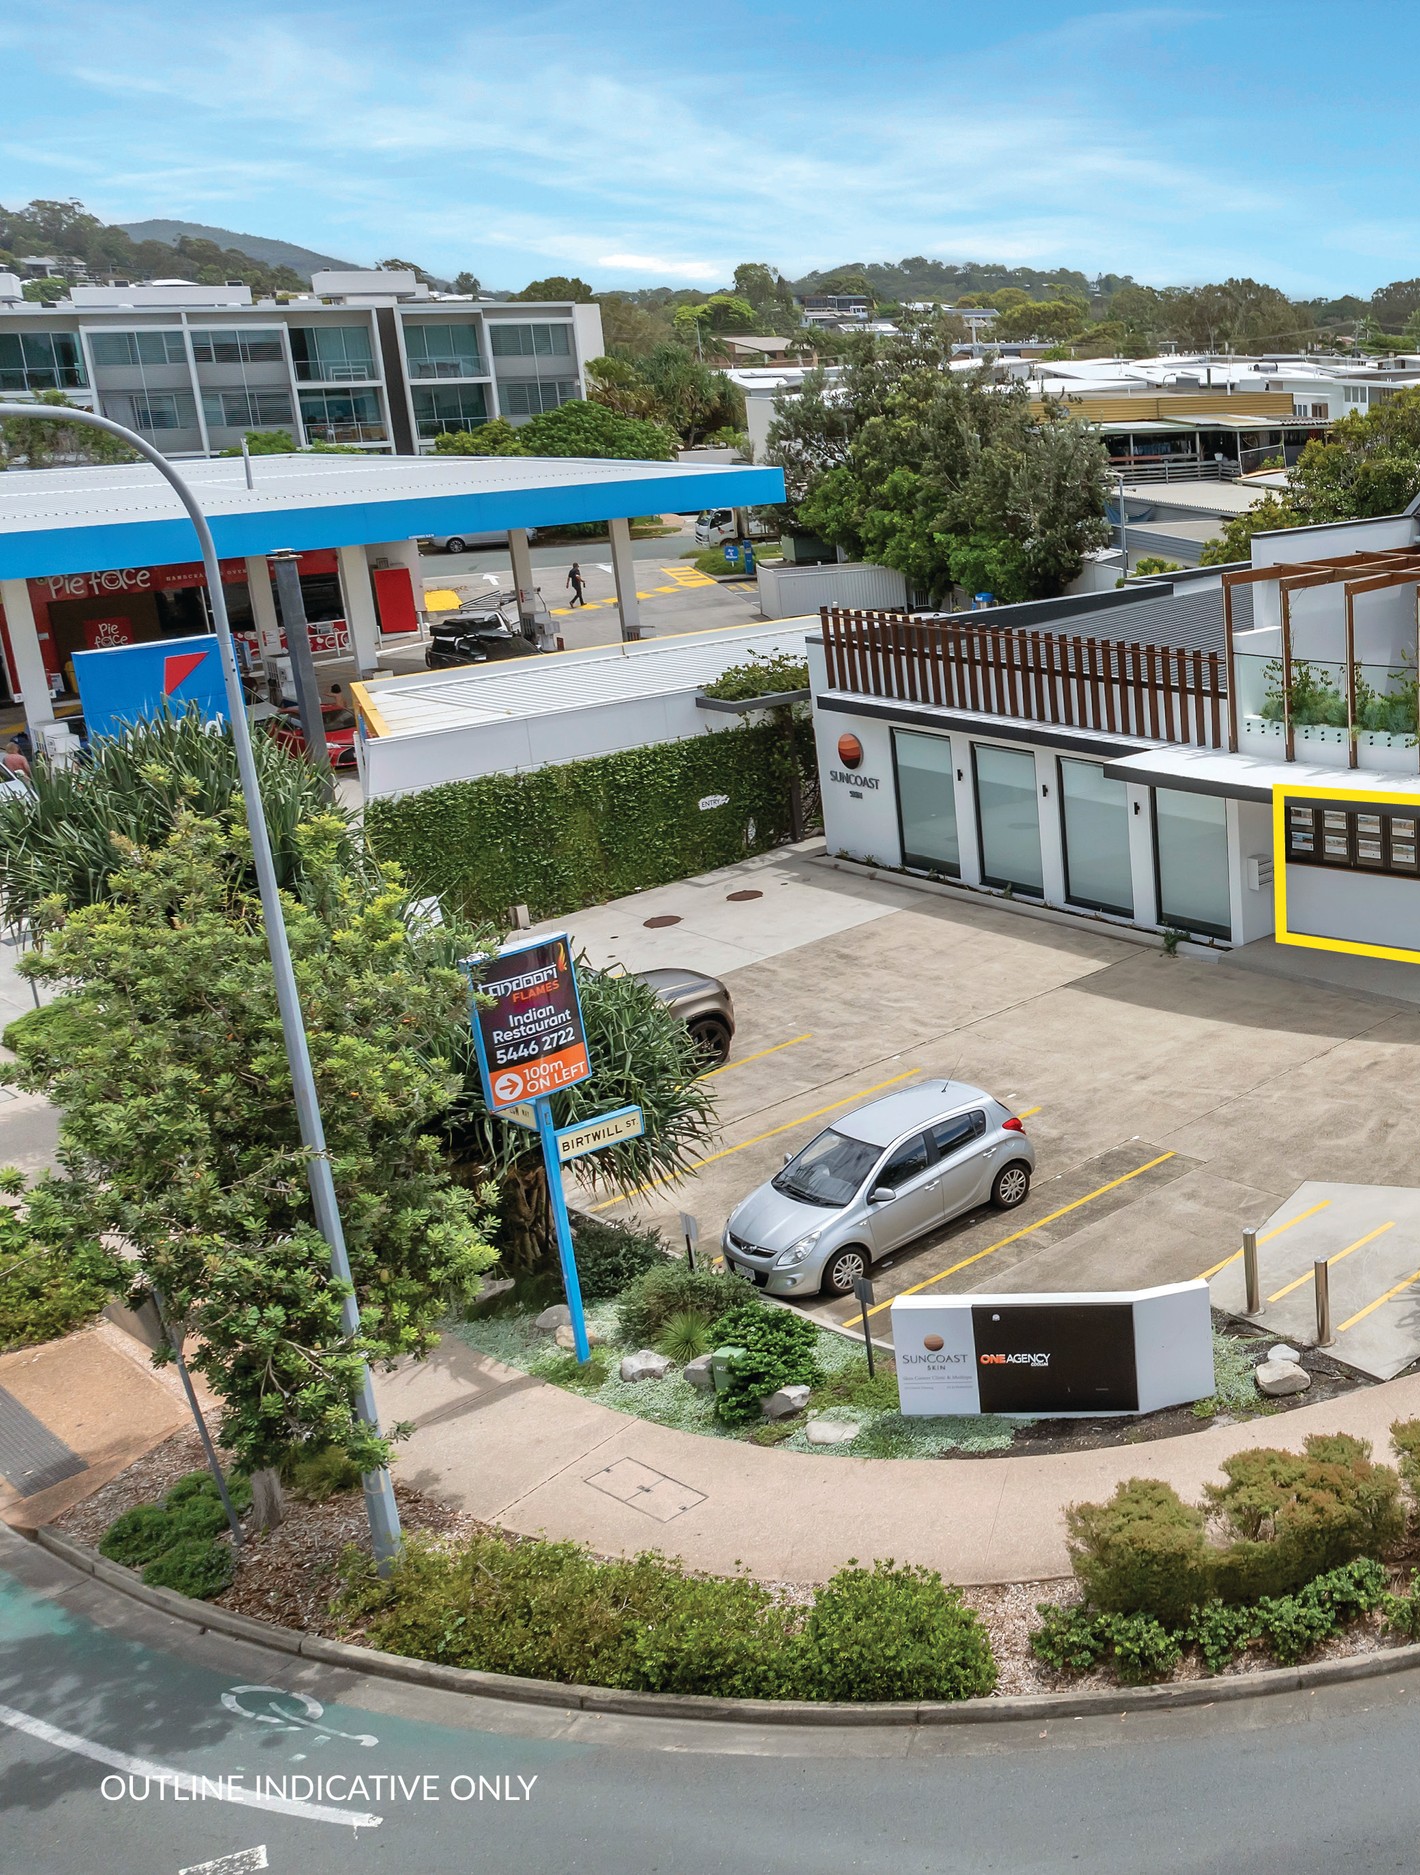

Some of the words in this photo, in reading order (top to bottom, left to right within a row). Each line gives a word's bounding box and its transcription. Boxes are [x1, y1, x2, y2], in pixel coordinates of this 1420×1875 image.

[829, 770, 880, 790] SUNCOAST
[701, 799, 720, 807] ENTRY
[512, 979, 560, 1003] FLAMES
[492, 1009, 572, 1044] Restaurant
[508, 1005, 555, 1027] Indian
[496, 1040, 539, 1064] 5446
[541, 1026, 575, 1051] 2722
[523, 1059, 564, 1079] 100m
[526, 1077, 551, 1093] ON
[554, 1062, 585, 1084] LEFT
[562, 1124, 623, 1152] BIRTWILL
[902, 1353, 968, 1364] SUNCOAST
